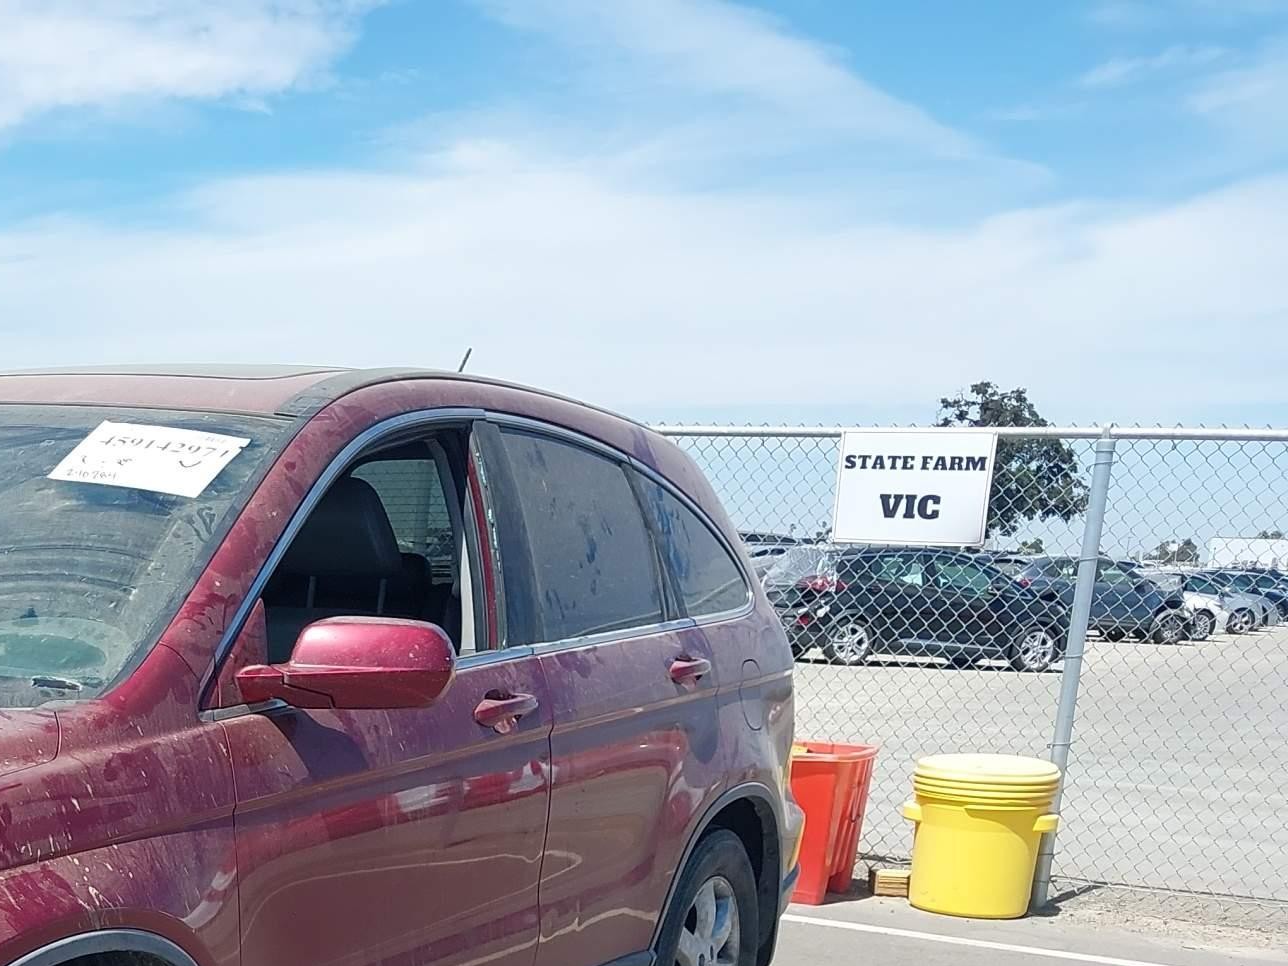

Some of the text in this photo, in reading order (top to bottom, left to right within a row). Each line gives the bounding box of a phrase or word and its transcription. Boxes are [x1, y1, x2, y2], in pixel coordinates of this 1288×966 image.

[844, 454, 988, 471] STATE FARM
[879, 493, 941, 520] VIC
